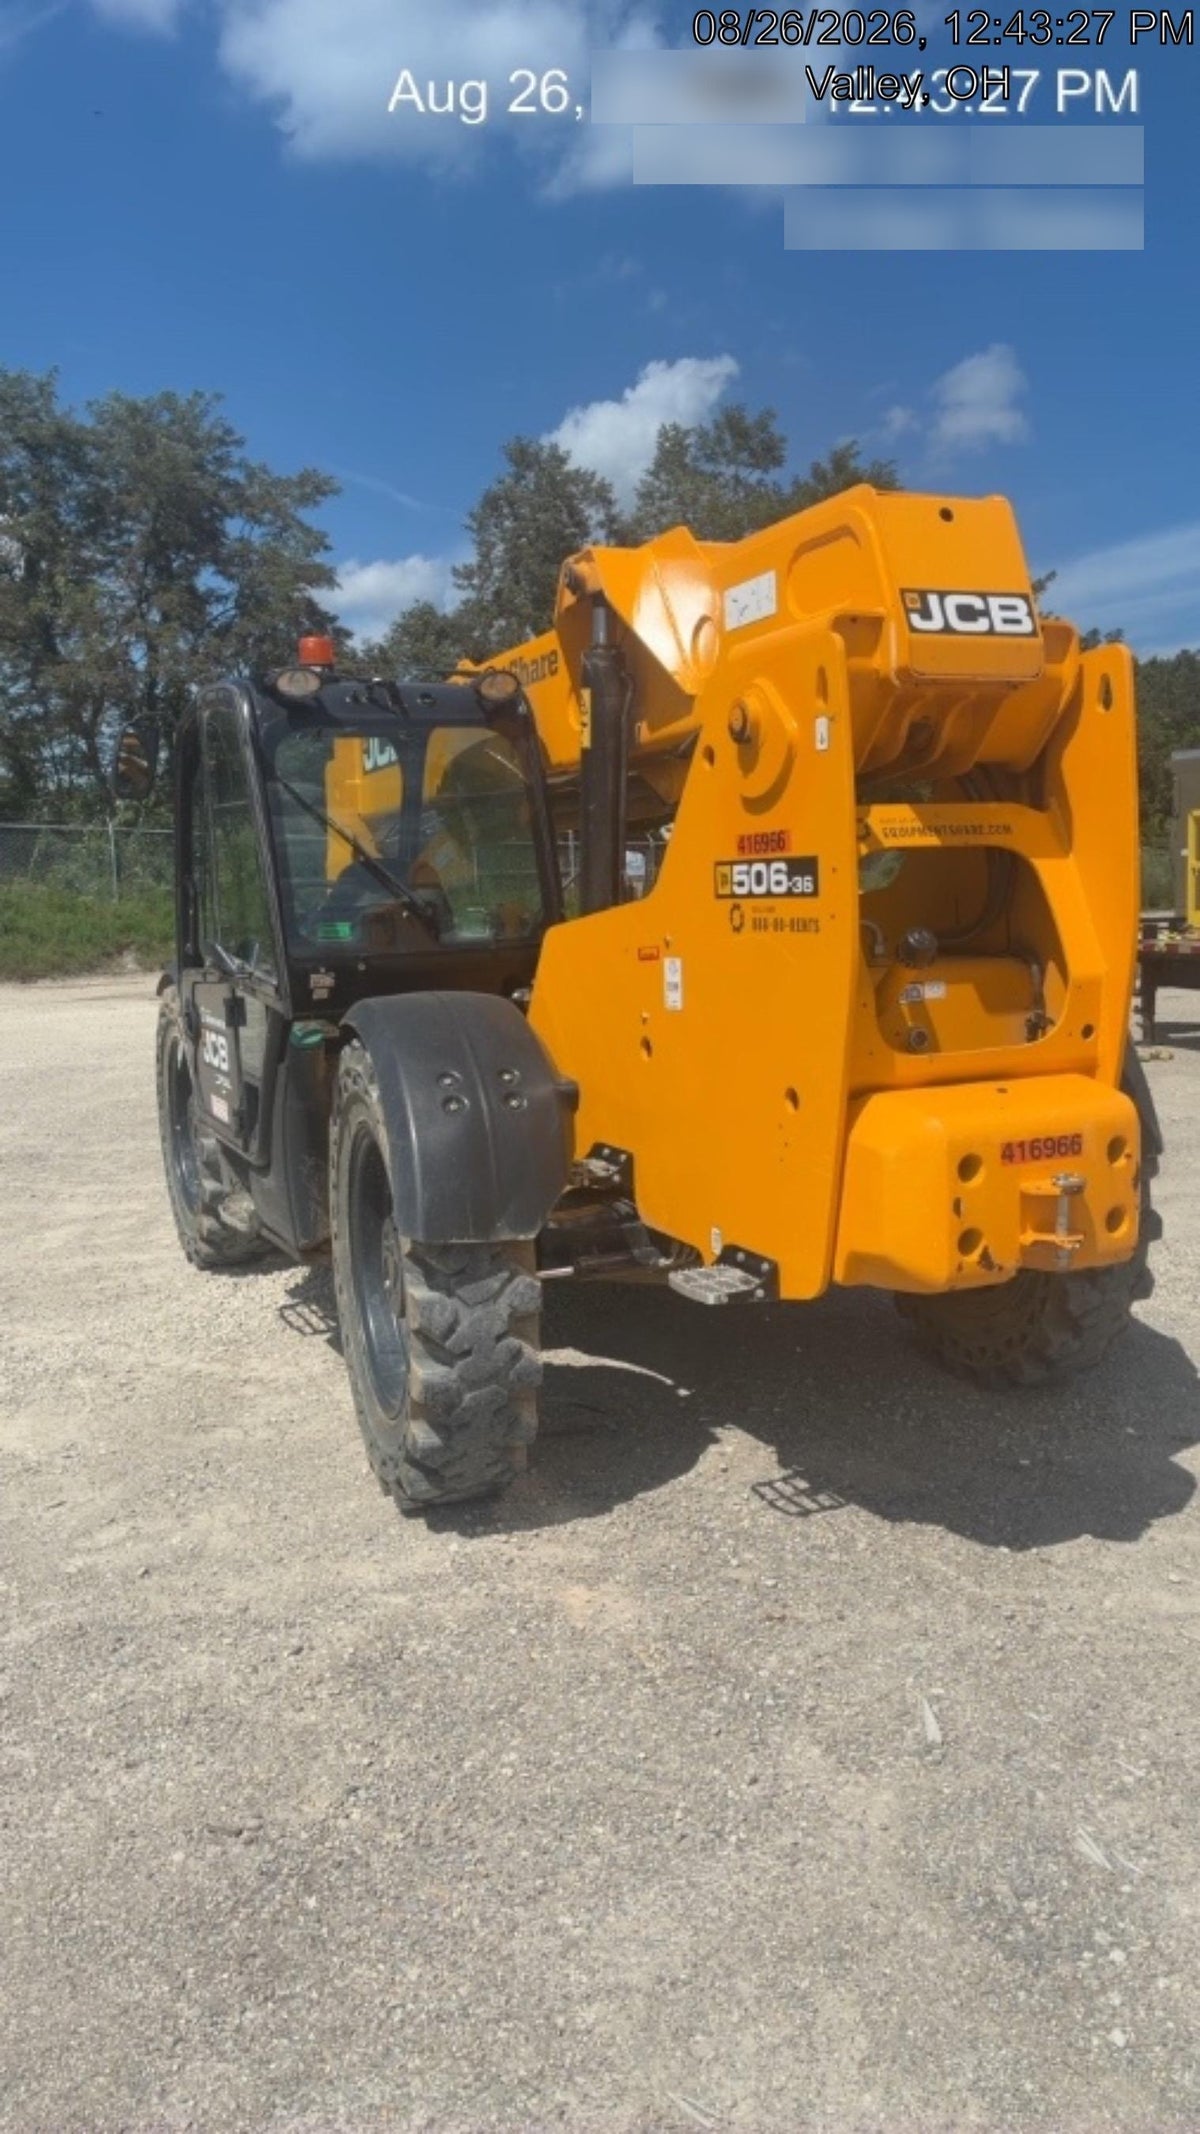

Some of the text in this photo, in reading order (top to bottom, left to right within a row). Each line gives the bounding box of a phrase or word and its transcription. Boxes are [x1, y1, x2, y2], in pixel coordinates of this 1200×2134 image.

[909, 592, 1035, 635] JCB
[737, 829, 787, 855] 416966
[201, 1027, 229, 1073] JCB
[1001, 1133, 1083, 1164] 416966
